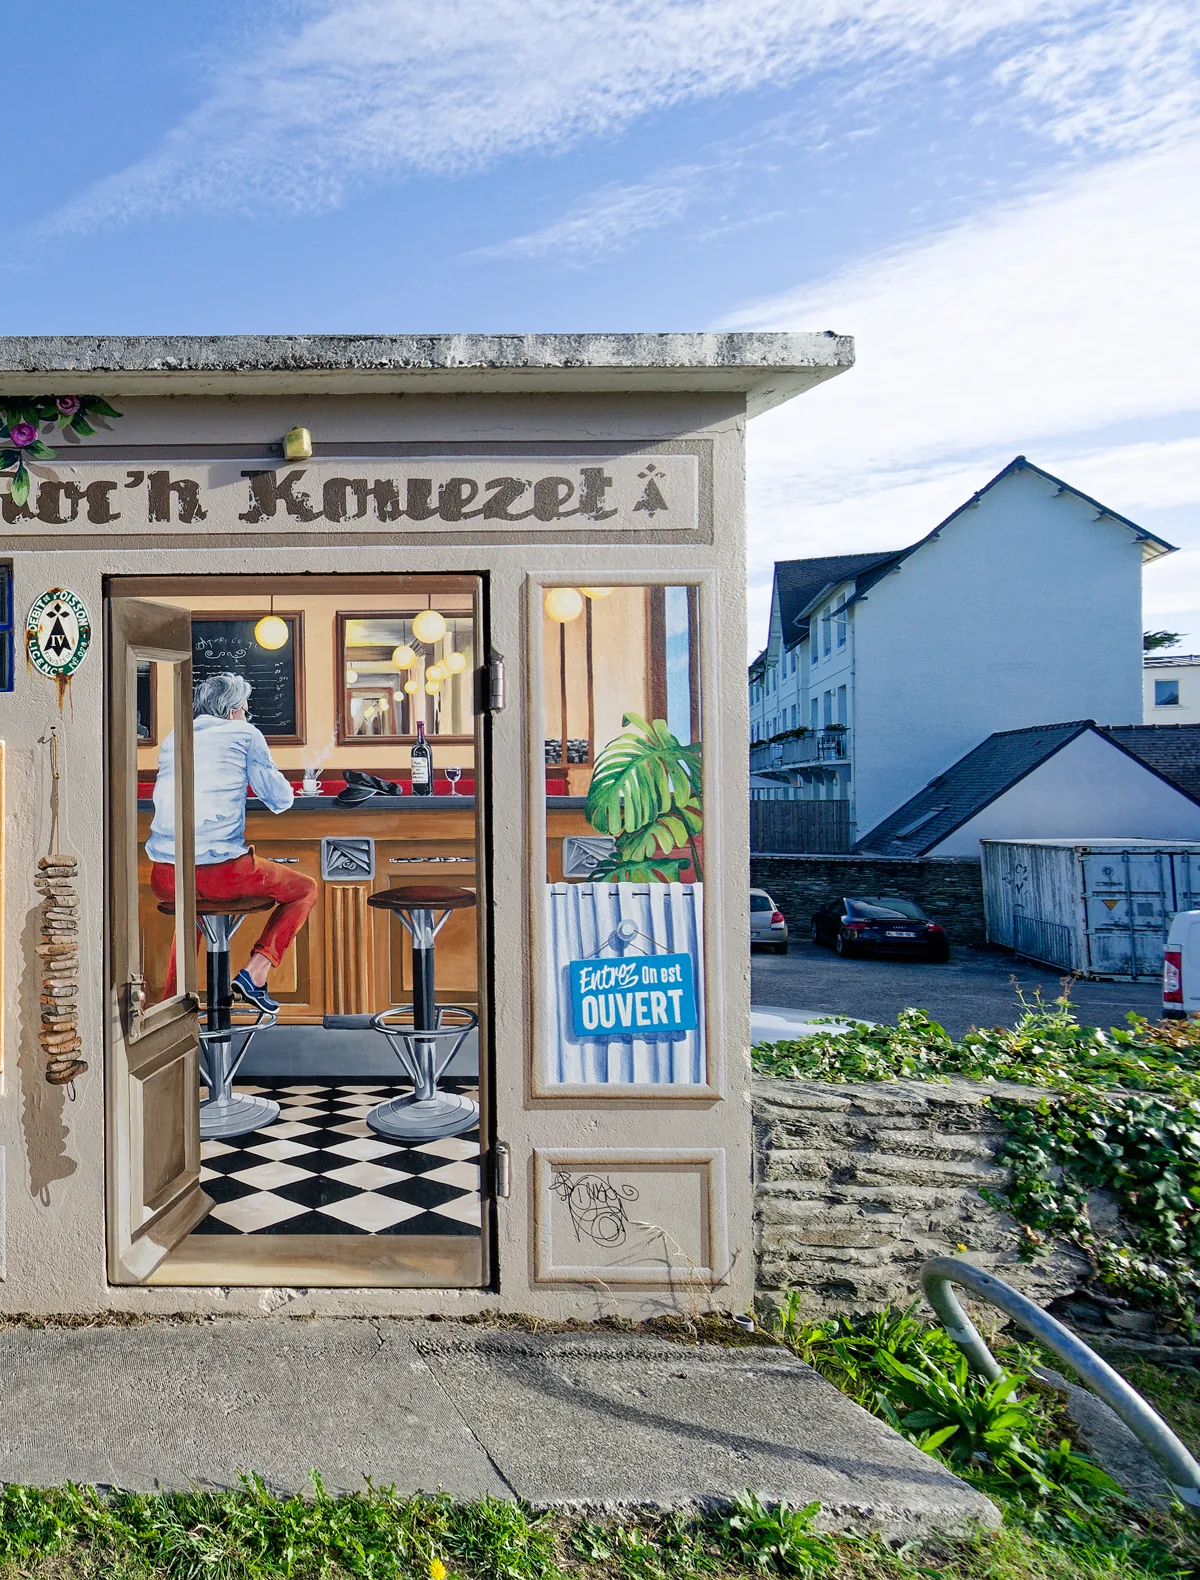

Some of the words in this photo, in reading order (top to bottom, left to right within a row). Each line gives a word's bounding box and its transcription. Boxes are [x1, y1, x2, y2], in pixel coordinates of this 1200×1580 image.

[50, 634, 65, 647] IV
[579, 962, 640, 994] Entrez
[641, 965, 658, 985] On
[660, 963, 683, 983] est
[581, 988, 684, 1030] OUVERT
